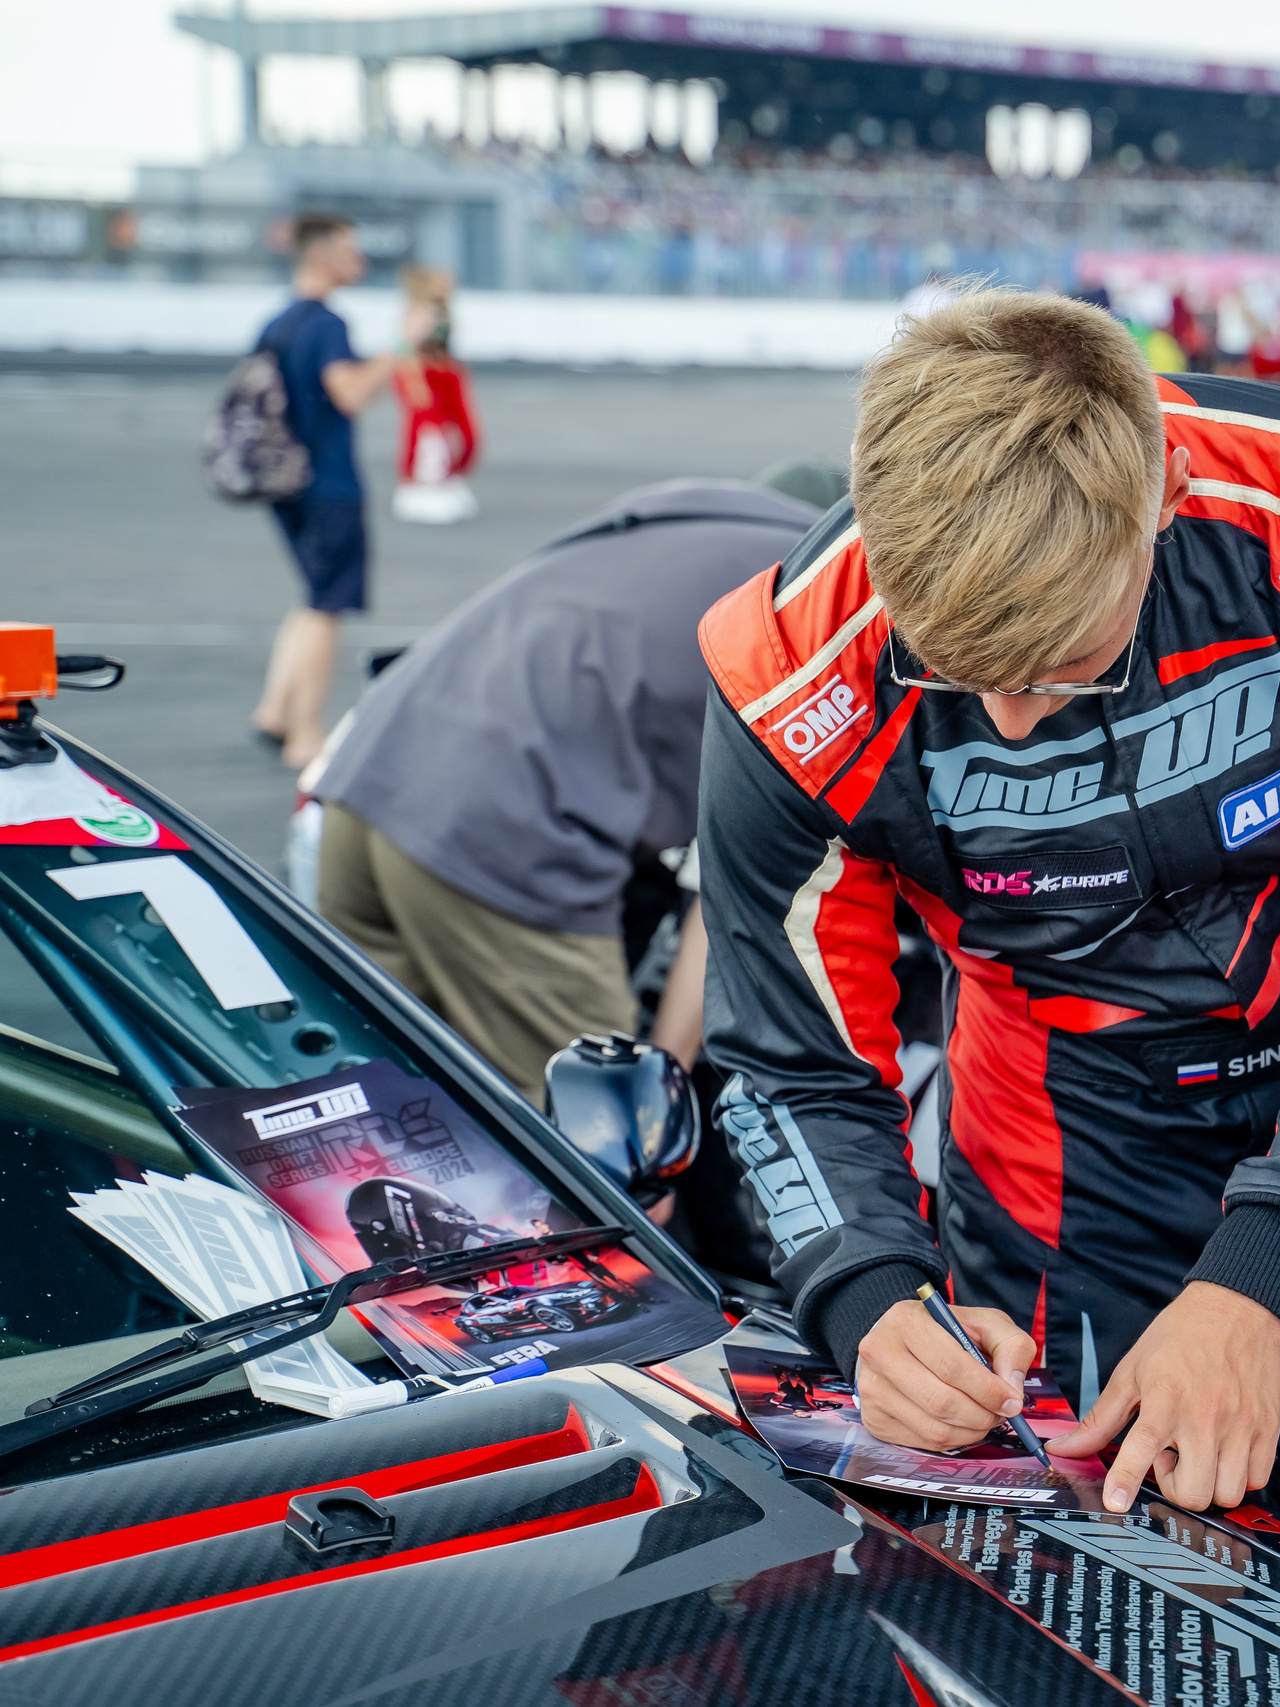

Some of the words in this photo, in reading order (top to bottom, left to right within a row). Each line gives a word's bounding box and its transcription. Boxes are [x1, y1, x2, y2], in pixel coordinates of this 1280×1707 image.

[783, 684, 855, 754] OMP
[962, 868, 1033, 896] RDS
[1060, 870, 1130, 890] EUROPE
[237, 1136, 312, 1165] RUSSIAN
[269, 1150, 318, 1173] DRIFT
[387, 1143, 463, 1177] EUROPE
[267, 1163, 329, 1188] SERIES
[428, 1157, 475, 1185] 2024
[941, 1526, 955, 1549] Taras
[958, 1531, 974, 1561] Dmitry
[1013, 1530, 1039, 1548] Ng
[1008, 1547, 1033, 1606] Charles
[1042, 1573, 1057, 1601] Nehay
[1067, 1553, 1088, 1613] Melkumyan
[1095, 1565, 1116, 1630] Tvardovskiy
[1125, 1578, 1142, 1631] Avsharov
[1040, 1601, 1053, 1629] Roman
[1149, 1590, 1166, 1649] Dmitrenko
[1066, 1614, 1085, 1653] Arthur
[1175, 1609, 1201, 1664] Anton
[1095, 1632, 1112, 1671] Maxim
[1123, 1631, 1141, 1694] Konstantin
